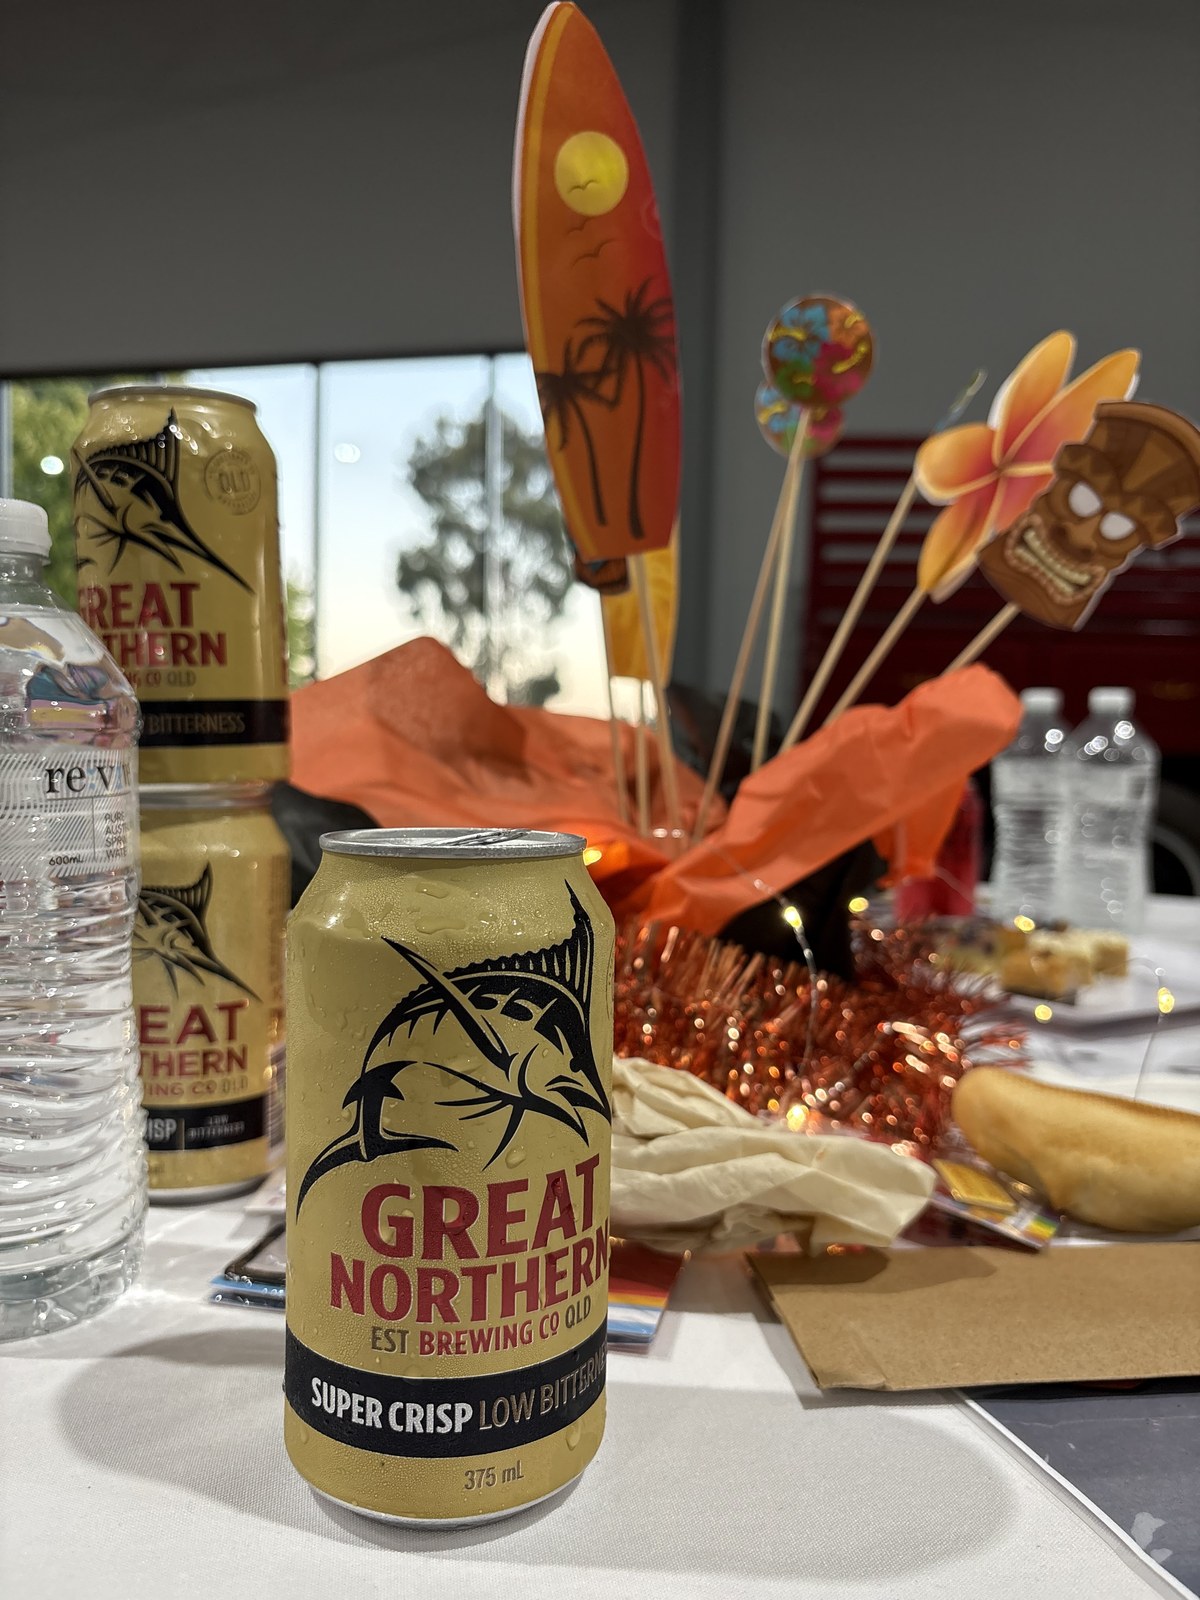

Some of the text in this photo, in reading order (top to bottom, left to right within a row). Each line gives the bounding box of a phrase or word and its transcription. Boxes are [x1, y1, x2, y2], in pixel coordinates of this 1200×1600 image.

[78, 582, 201, 629] REAT
[102, 630, 228, 668] THERN
[147, 711, 246, 735] BITTERNESS
[139, 1001, 249, 1045] EAT
[140, 1046, 248, 1078] THERN
[360, 1153, 600, 1260] GREAT
[330, 1217, 609, 1324] NORTHERN
[371, 1326, 409, 1355] EST
[419, 1321, 534, 1357] BREWING
[565, 1295, 591, 1329] QLD
[311, 1377, 383, 1429] SUPER
[388, 1401, 474, 1433] CRISP
[479, 1393, 535, 1431] LOW
[464, 1460, 525, 1491] 375 mL
